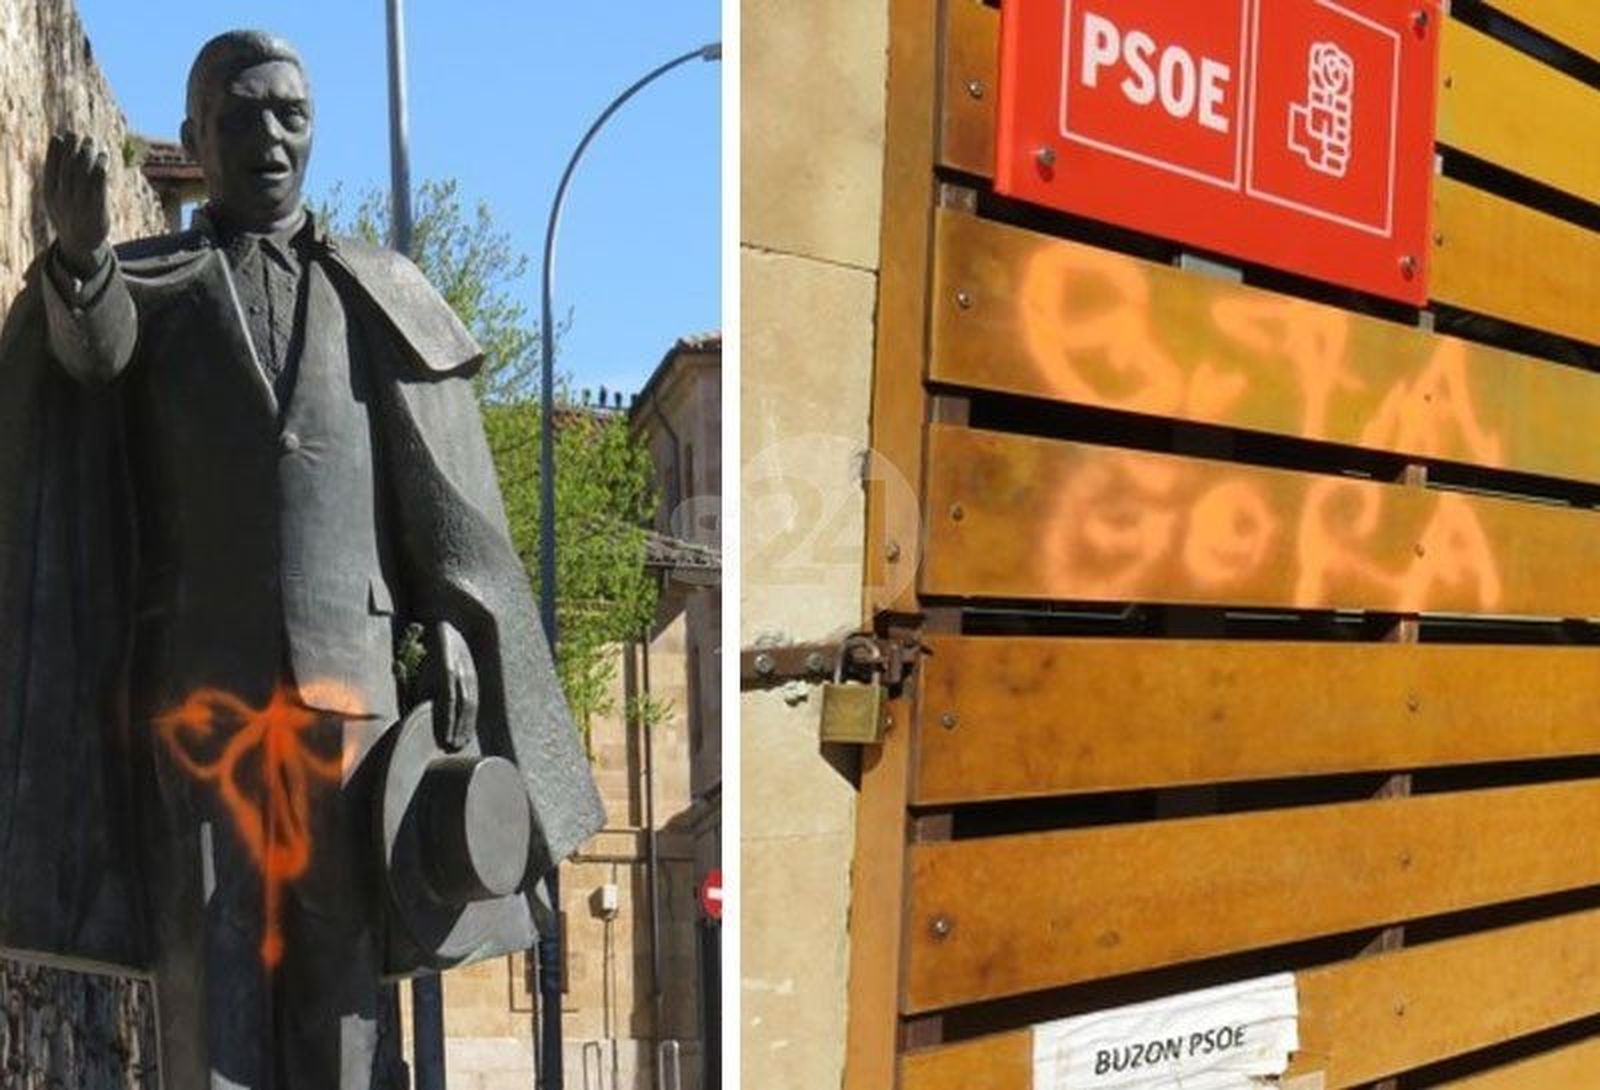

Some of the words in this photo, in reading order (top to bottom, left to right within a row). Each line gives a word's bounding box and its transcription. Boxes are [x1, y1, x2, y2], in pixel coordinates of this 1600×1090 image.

[1081, 12, 1230, 134] PSOE
[1042, 448, 1502, 610] GORA
[1094, 1037, 1184, 1075] BUZON
[1189, 1024, 1248, 1057] PSOE
